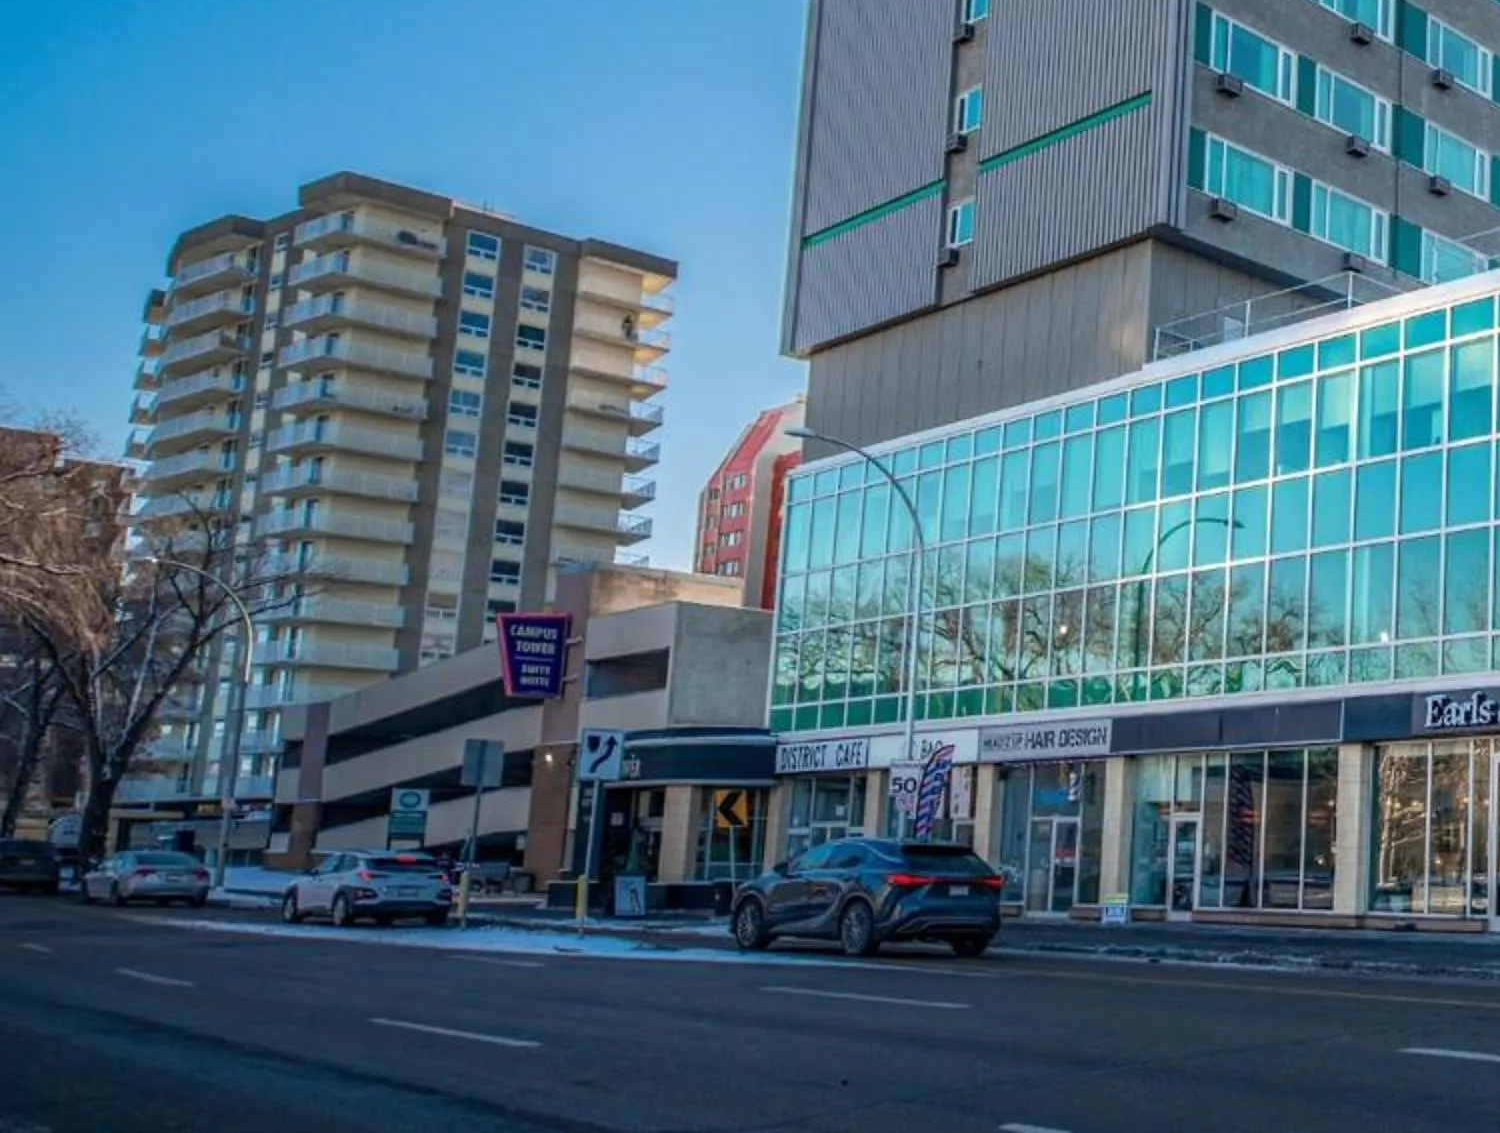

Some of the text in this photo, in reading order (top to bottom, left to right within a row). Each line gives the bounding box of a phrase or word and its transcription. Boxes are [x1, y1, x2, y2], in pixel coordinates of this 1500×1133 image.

[510, 624, 558, 640] CAMPUS
[515, 640, 556, 655] TOWER
[1424, 691, 1496, 728] Earls
[1025, 730, 1055, 749] HAIR
[1058, 725, 1108, 748] DESIGN
[781, 741, 863, 770] DISTRICT CAFE
[892, 777, 917, 794] 50
